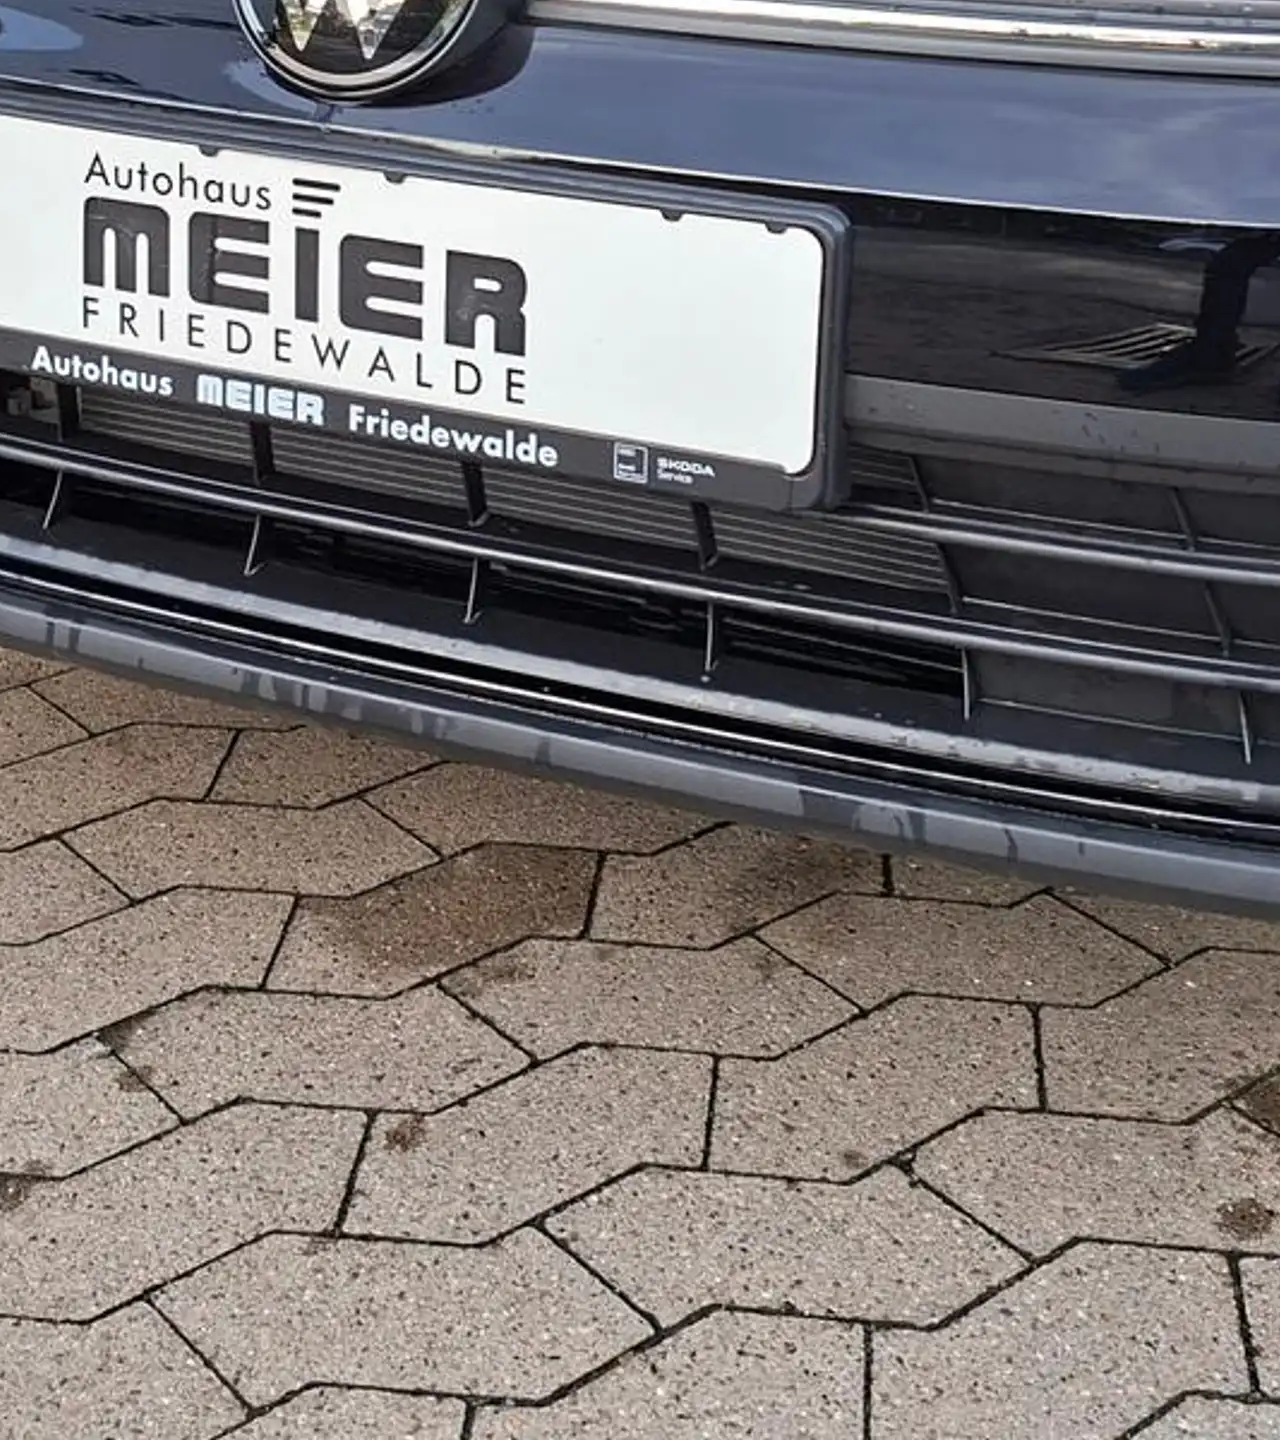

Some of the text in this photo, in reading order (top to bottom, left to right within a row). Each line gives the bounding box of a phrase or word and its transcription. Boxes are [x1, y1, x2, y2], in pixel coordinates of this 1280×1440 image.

[84, 153, 272, 211] Autohaus
[83, 196, 528, 357] MEIER
[30, 345, 559, 468] Autohaus MEIER Friedewalde
[82, 296, 527, 405] FRIEDEWALDE
